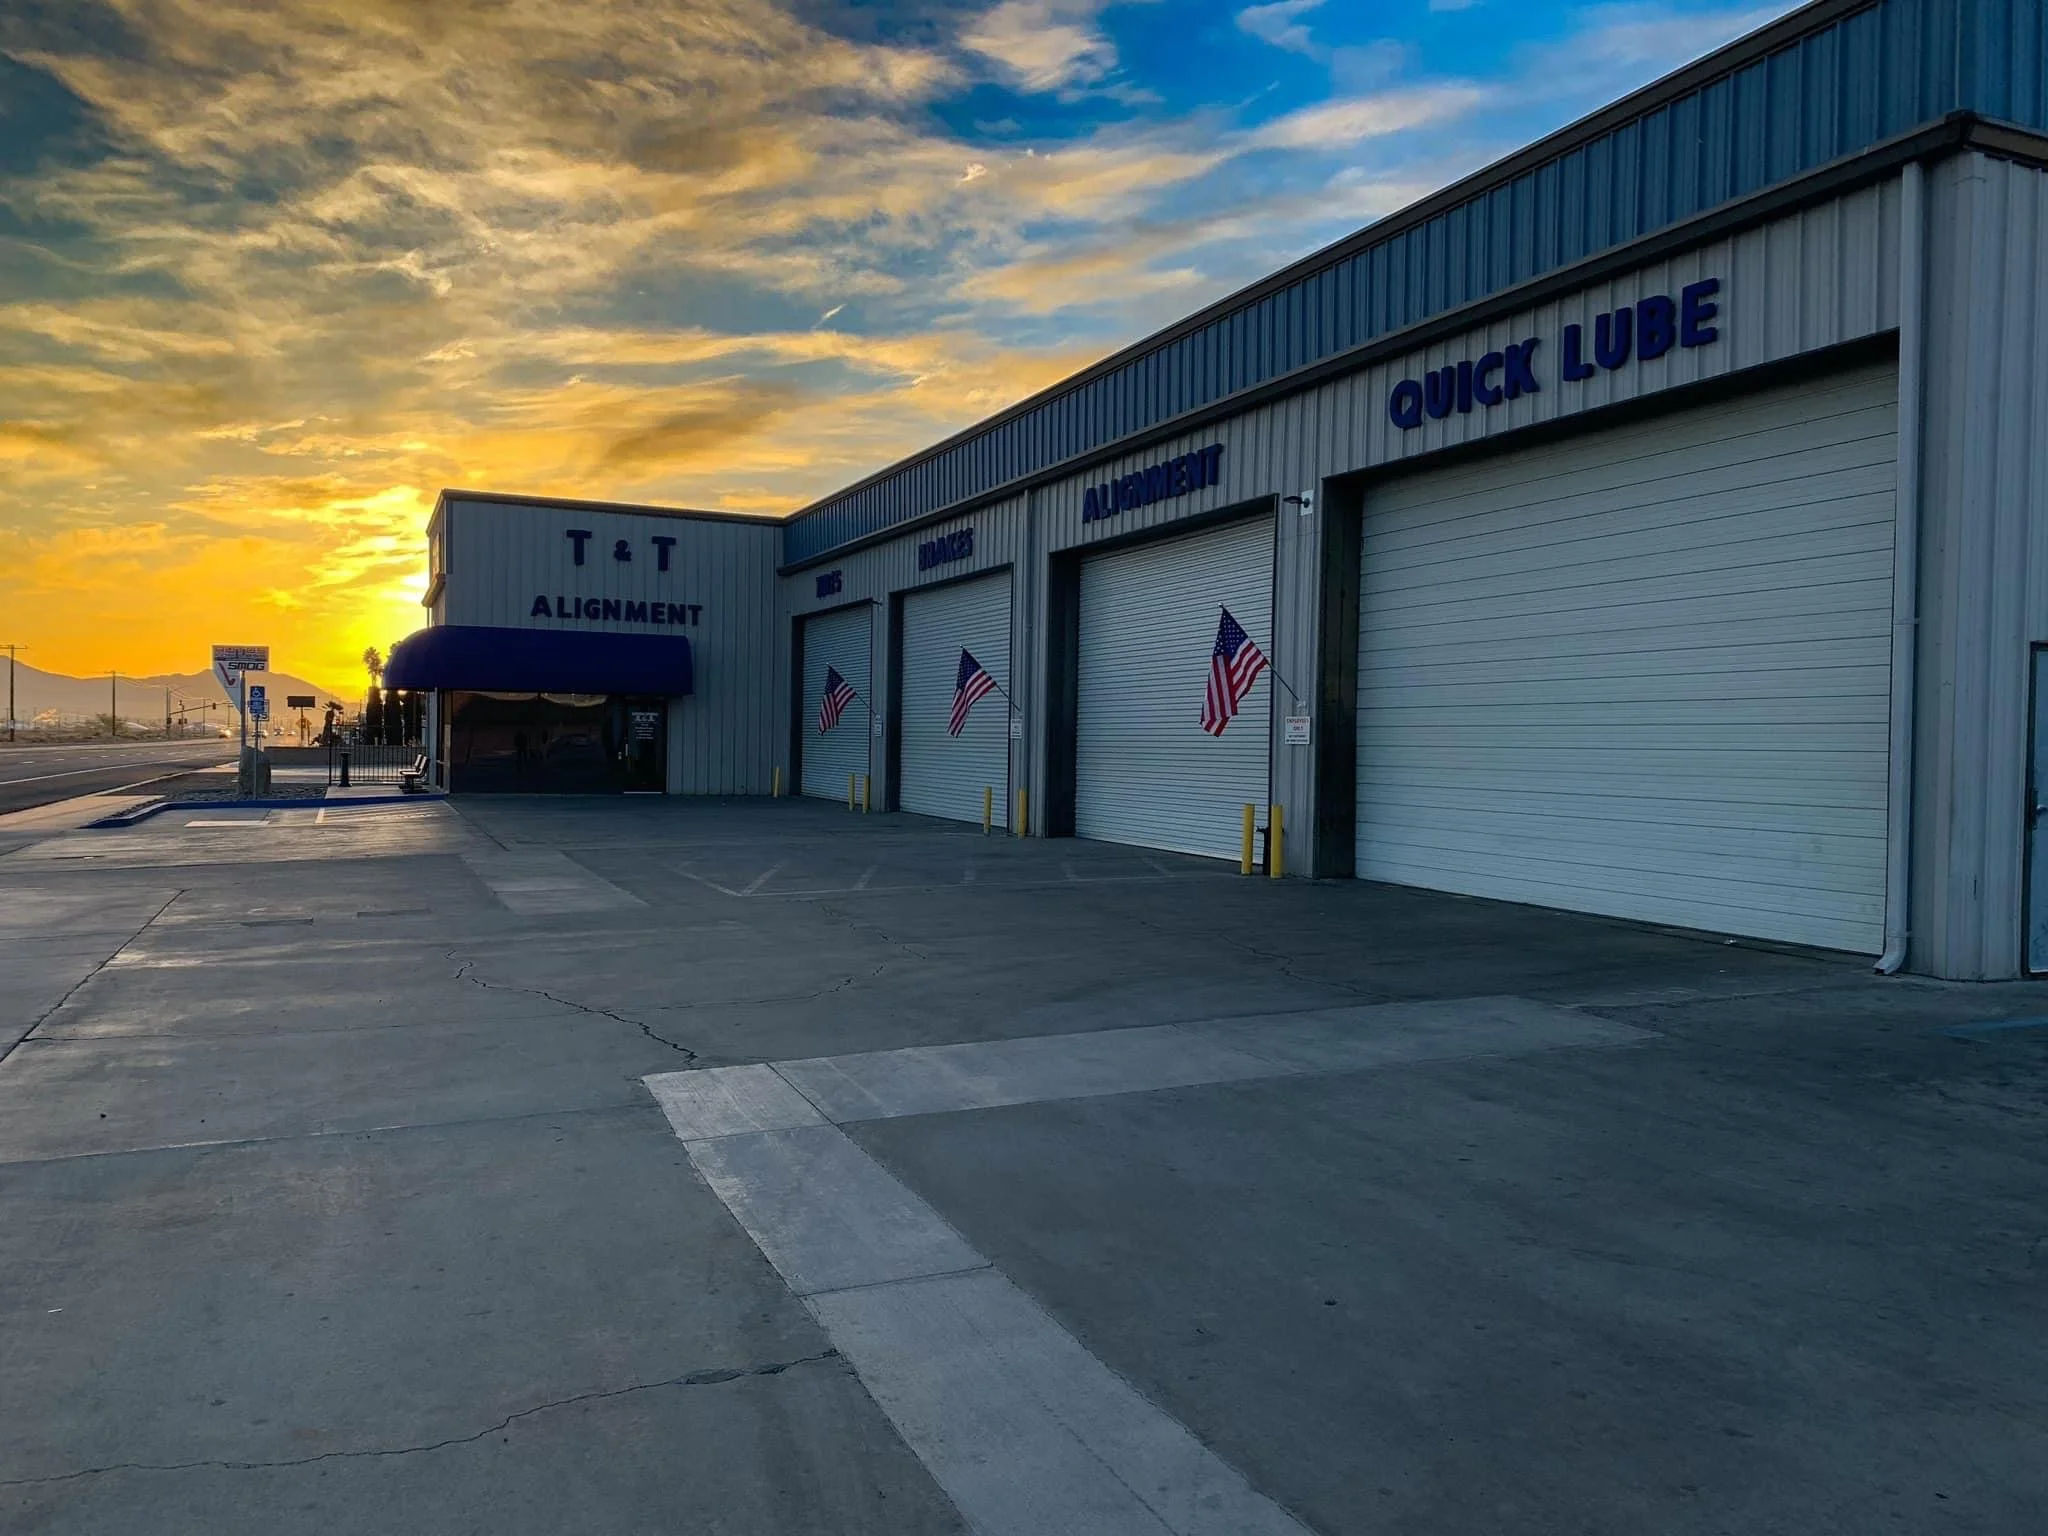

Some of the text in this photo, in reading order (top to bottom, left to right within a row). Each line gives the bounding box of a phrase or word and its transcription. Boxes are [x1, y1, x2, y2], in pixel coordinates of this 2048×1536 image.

[1389, 277, 1720, 431] QUICK LUBE
[1082, 443, 1224, 524] ALIGNMENT
[566, 529, 677, 572] T & T
[530, 595, 703, 626] ALIGNMENT
[228, 661, 265, 671] SMOG
